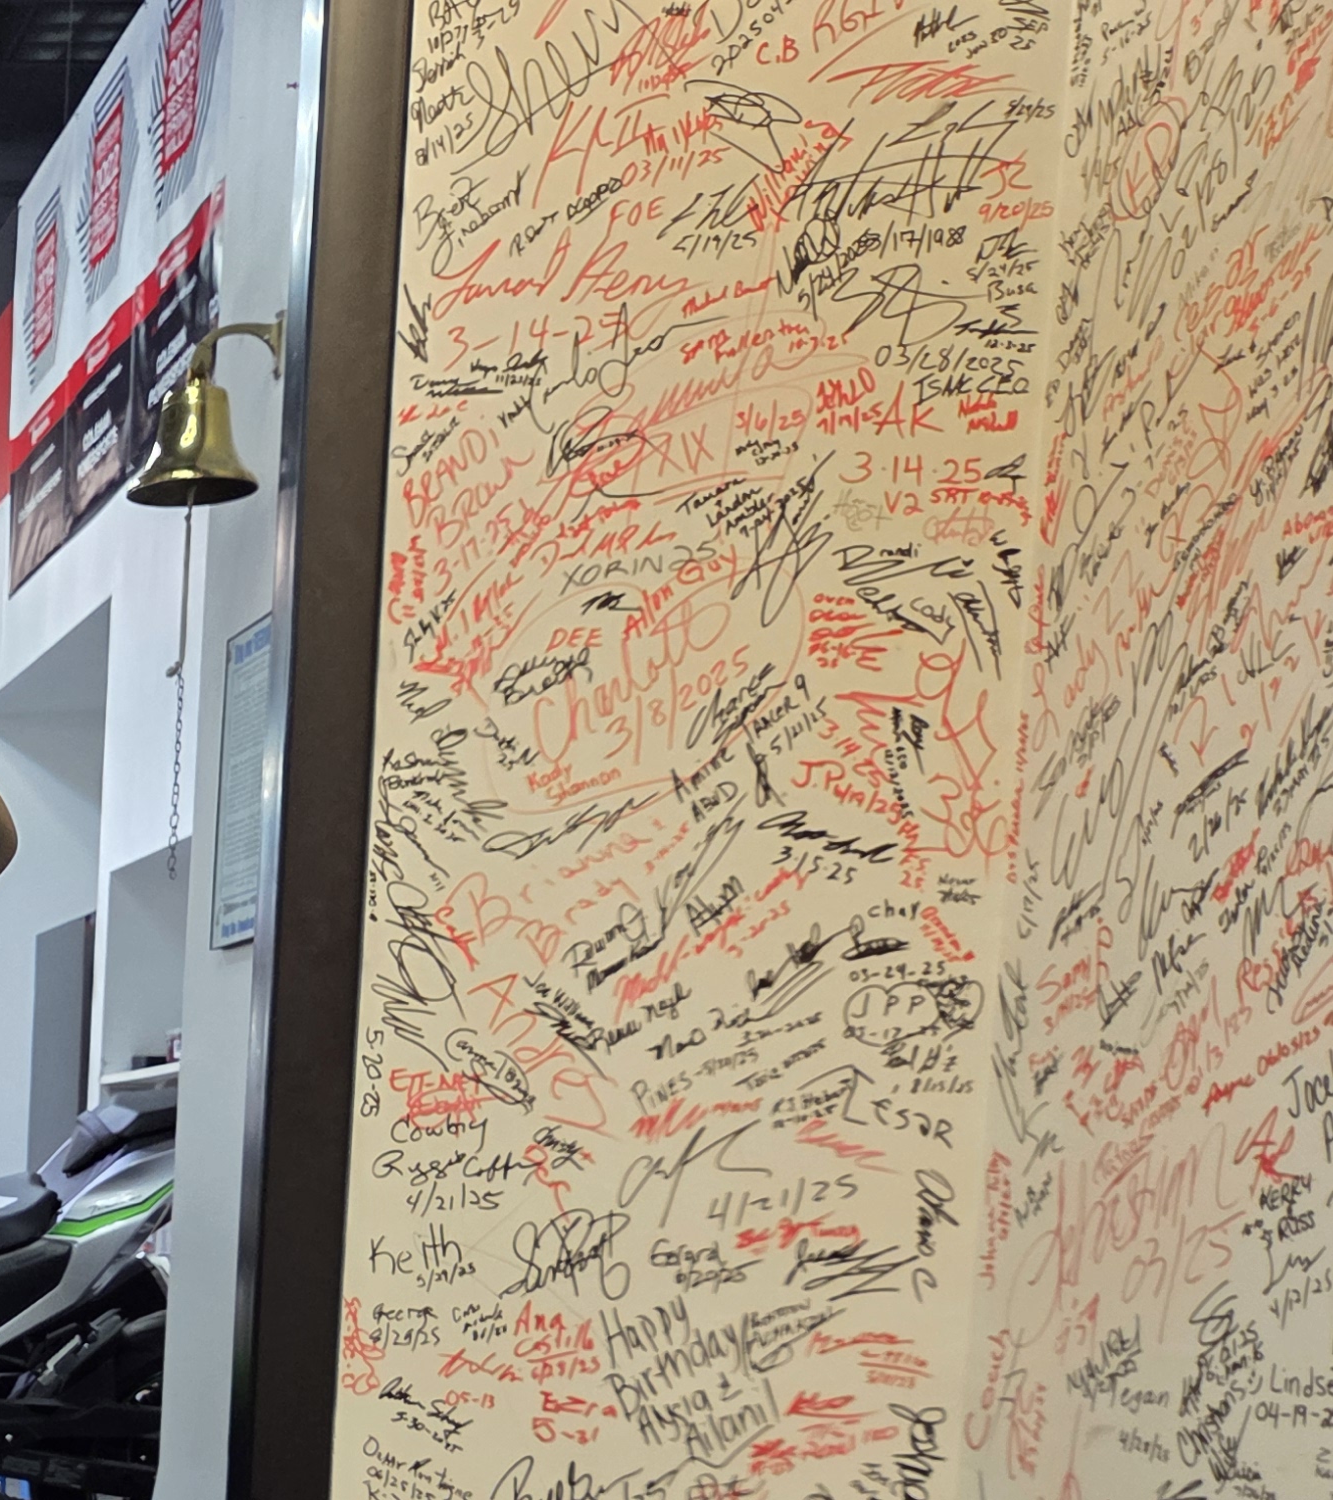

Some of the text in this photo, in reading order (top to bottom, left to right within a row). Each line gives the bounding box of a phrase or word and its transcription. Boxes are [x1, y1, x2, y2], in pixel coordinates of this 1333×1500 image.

[546, 627, 603, 651] DEE
[370, 1222, 462, 1275] Keith
[599, 1294, 691, 1370] Happy
